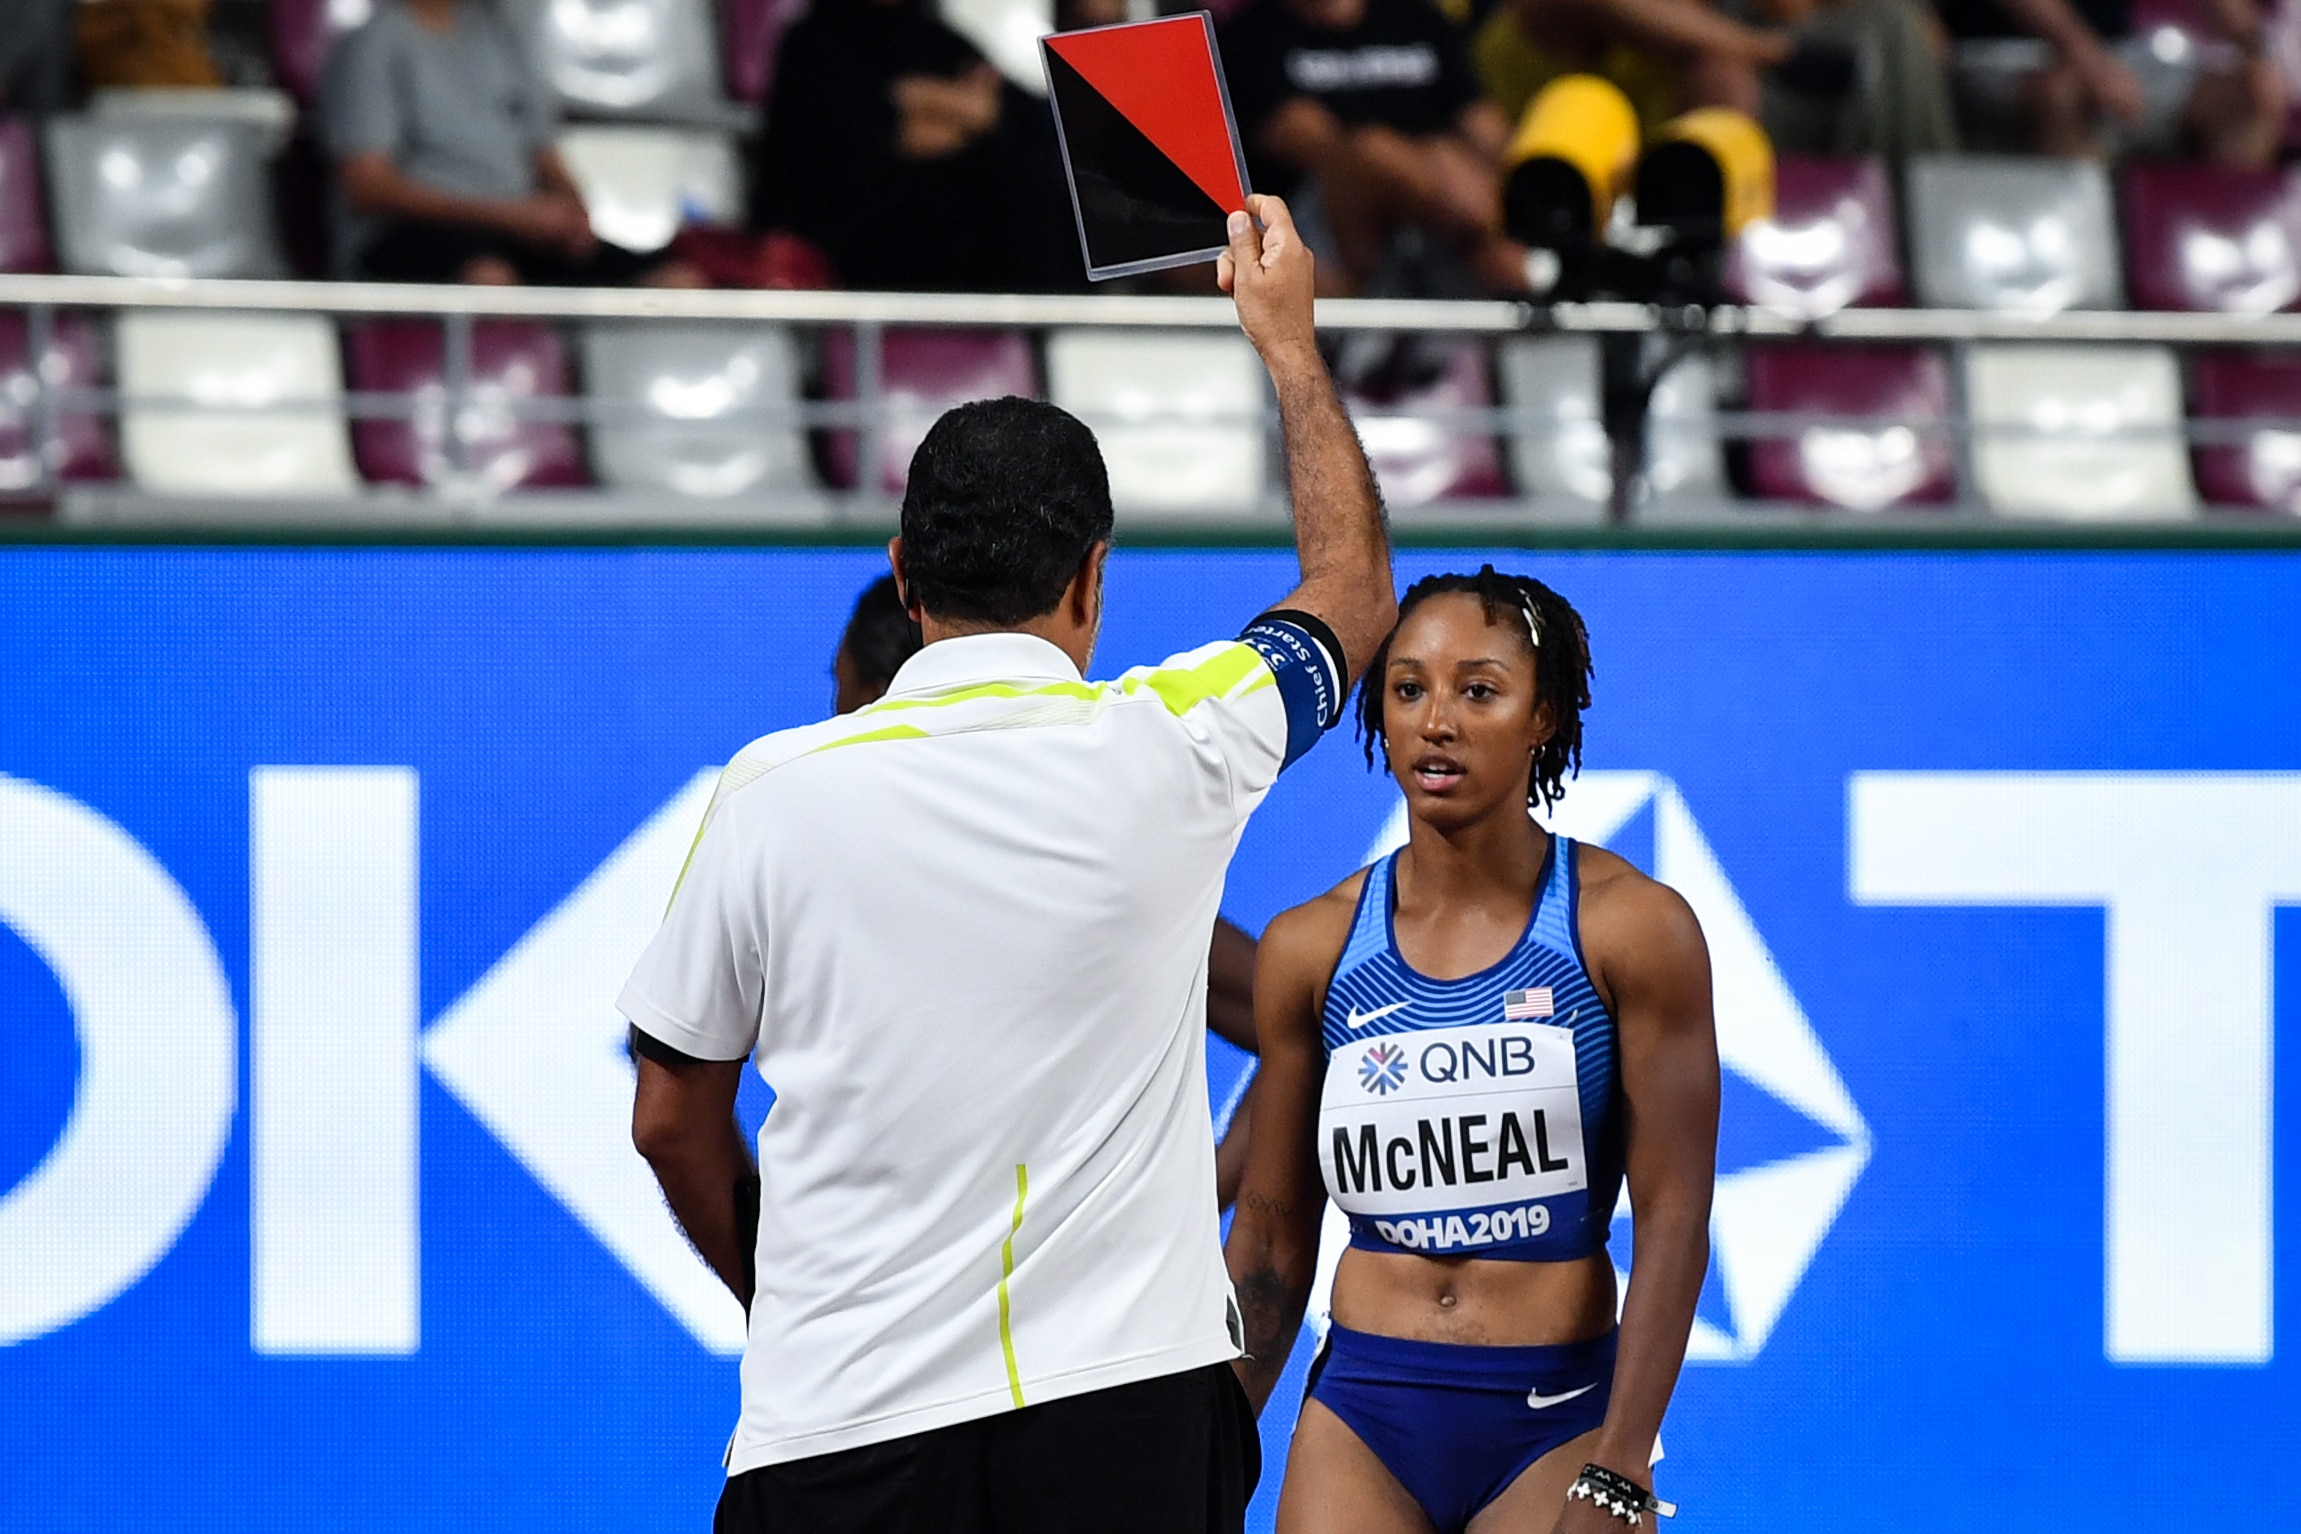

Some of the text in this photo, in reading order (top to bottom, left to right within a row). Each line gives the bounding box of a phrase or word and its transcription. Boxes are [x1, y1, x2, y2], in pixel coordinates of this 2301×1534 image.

[1305, 664, 1328, 727] Chief
[1419, 1036, 1536, 1083] QNB
[1332, 1109, 1569, 1194] McNEAL
[1375, 1204, 1550, 1249] DOHA2019
